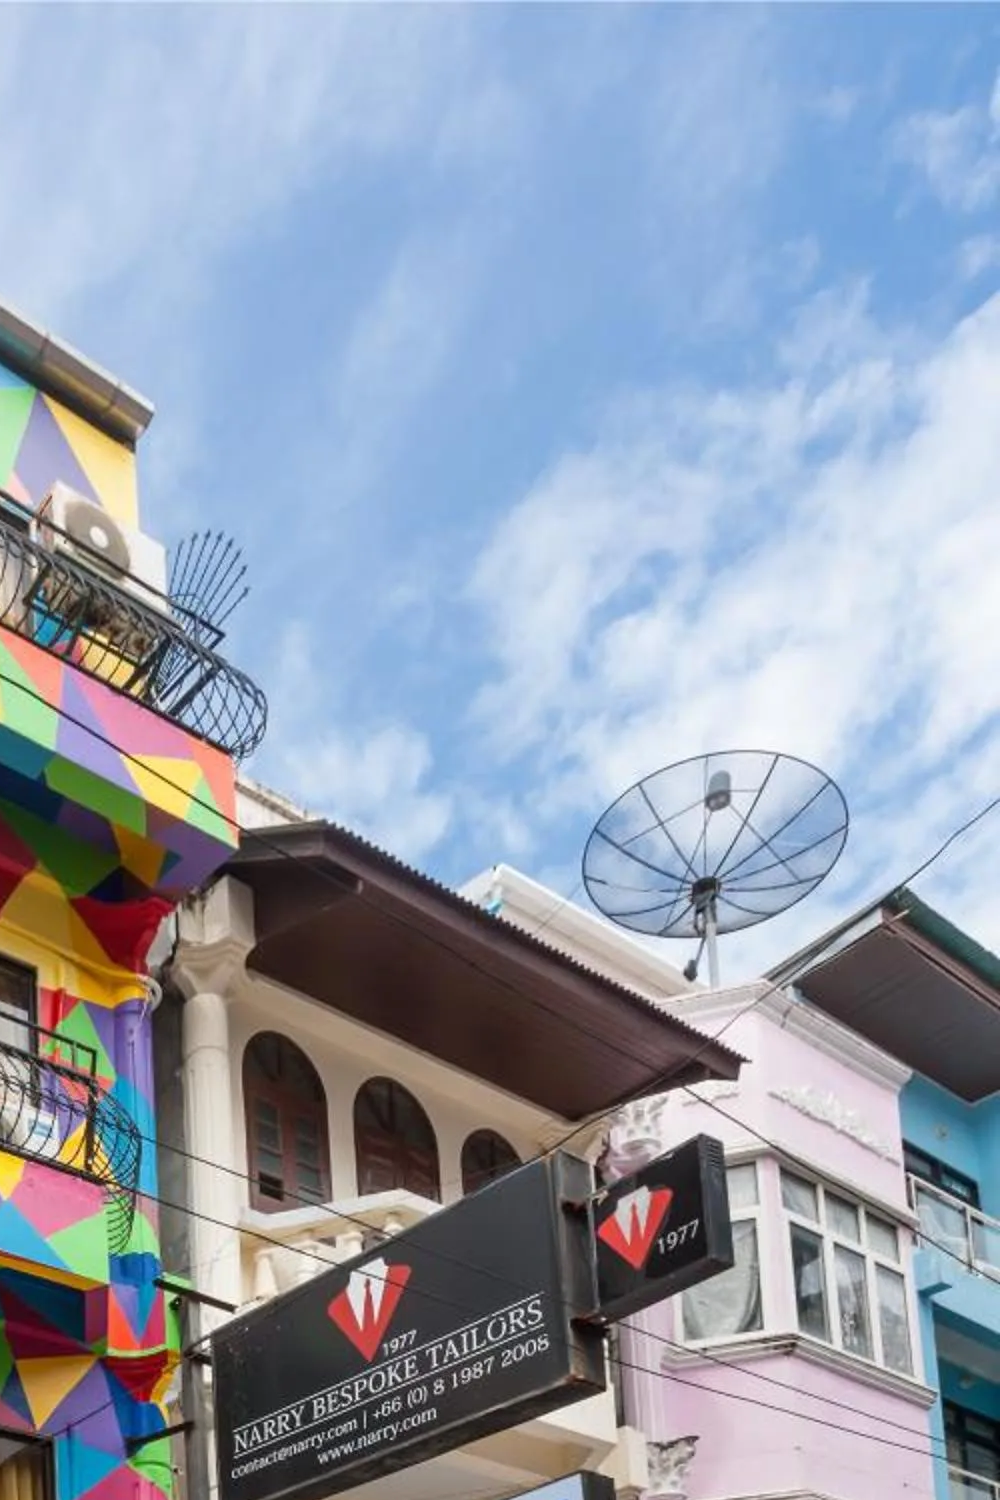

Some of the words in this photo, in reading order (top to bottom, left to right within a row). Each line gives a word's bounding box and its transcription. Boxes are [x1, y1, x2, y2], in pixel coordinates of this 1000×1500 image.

[657, 1218, 699, 1255] 1977
[383, 1329, 418, 1356] 1977
[233, 1405, 306, 1453] NARRY
[312, 1355, 419, 1420] BESPOKE
[425, 1299, 544, 1369] TAILORS
[231, 1418, 358, 1479] contact@narry.com
[372, 1396, 402, 1420] +66
[407, 1386, 428, 1408] (0)
[433, 1379, 445, 1395] 8
[451, 1356, 495, 1389] 1987
[501, 1333, 550, 1368] 2008
[316, 1407, 438, 1465] www.narry.com
